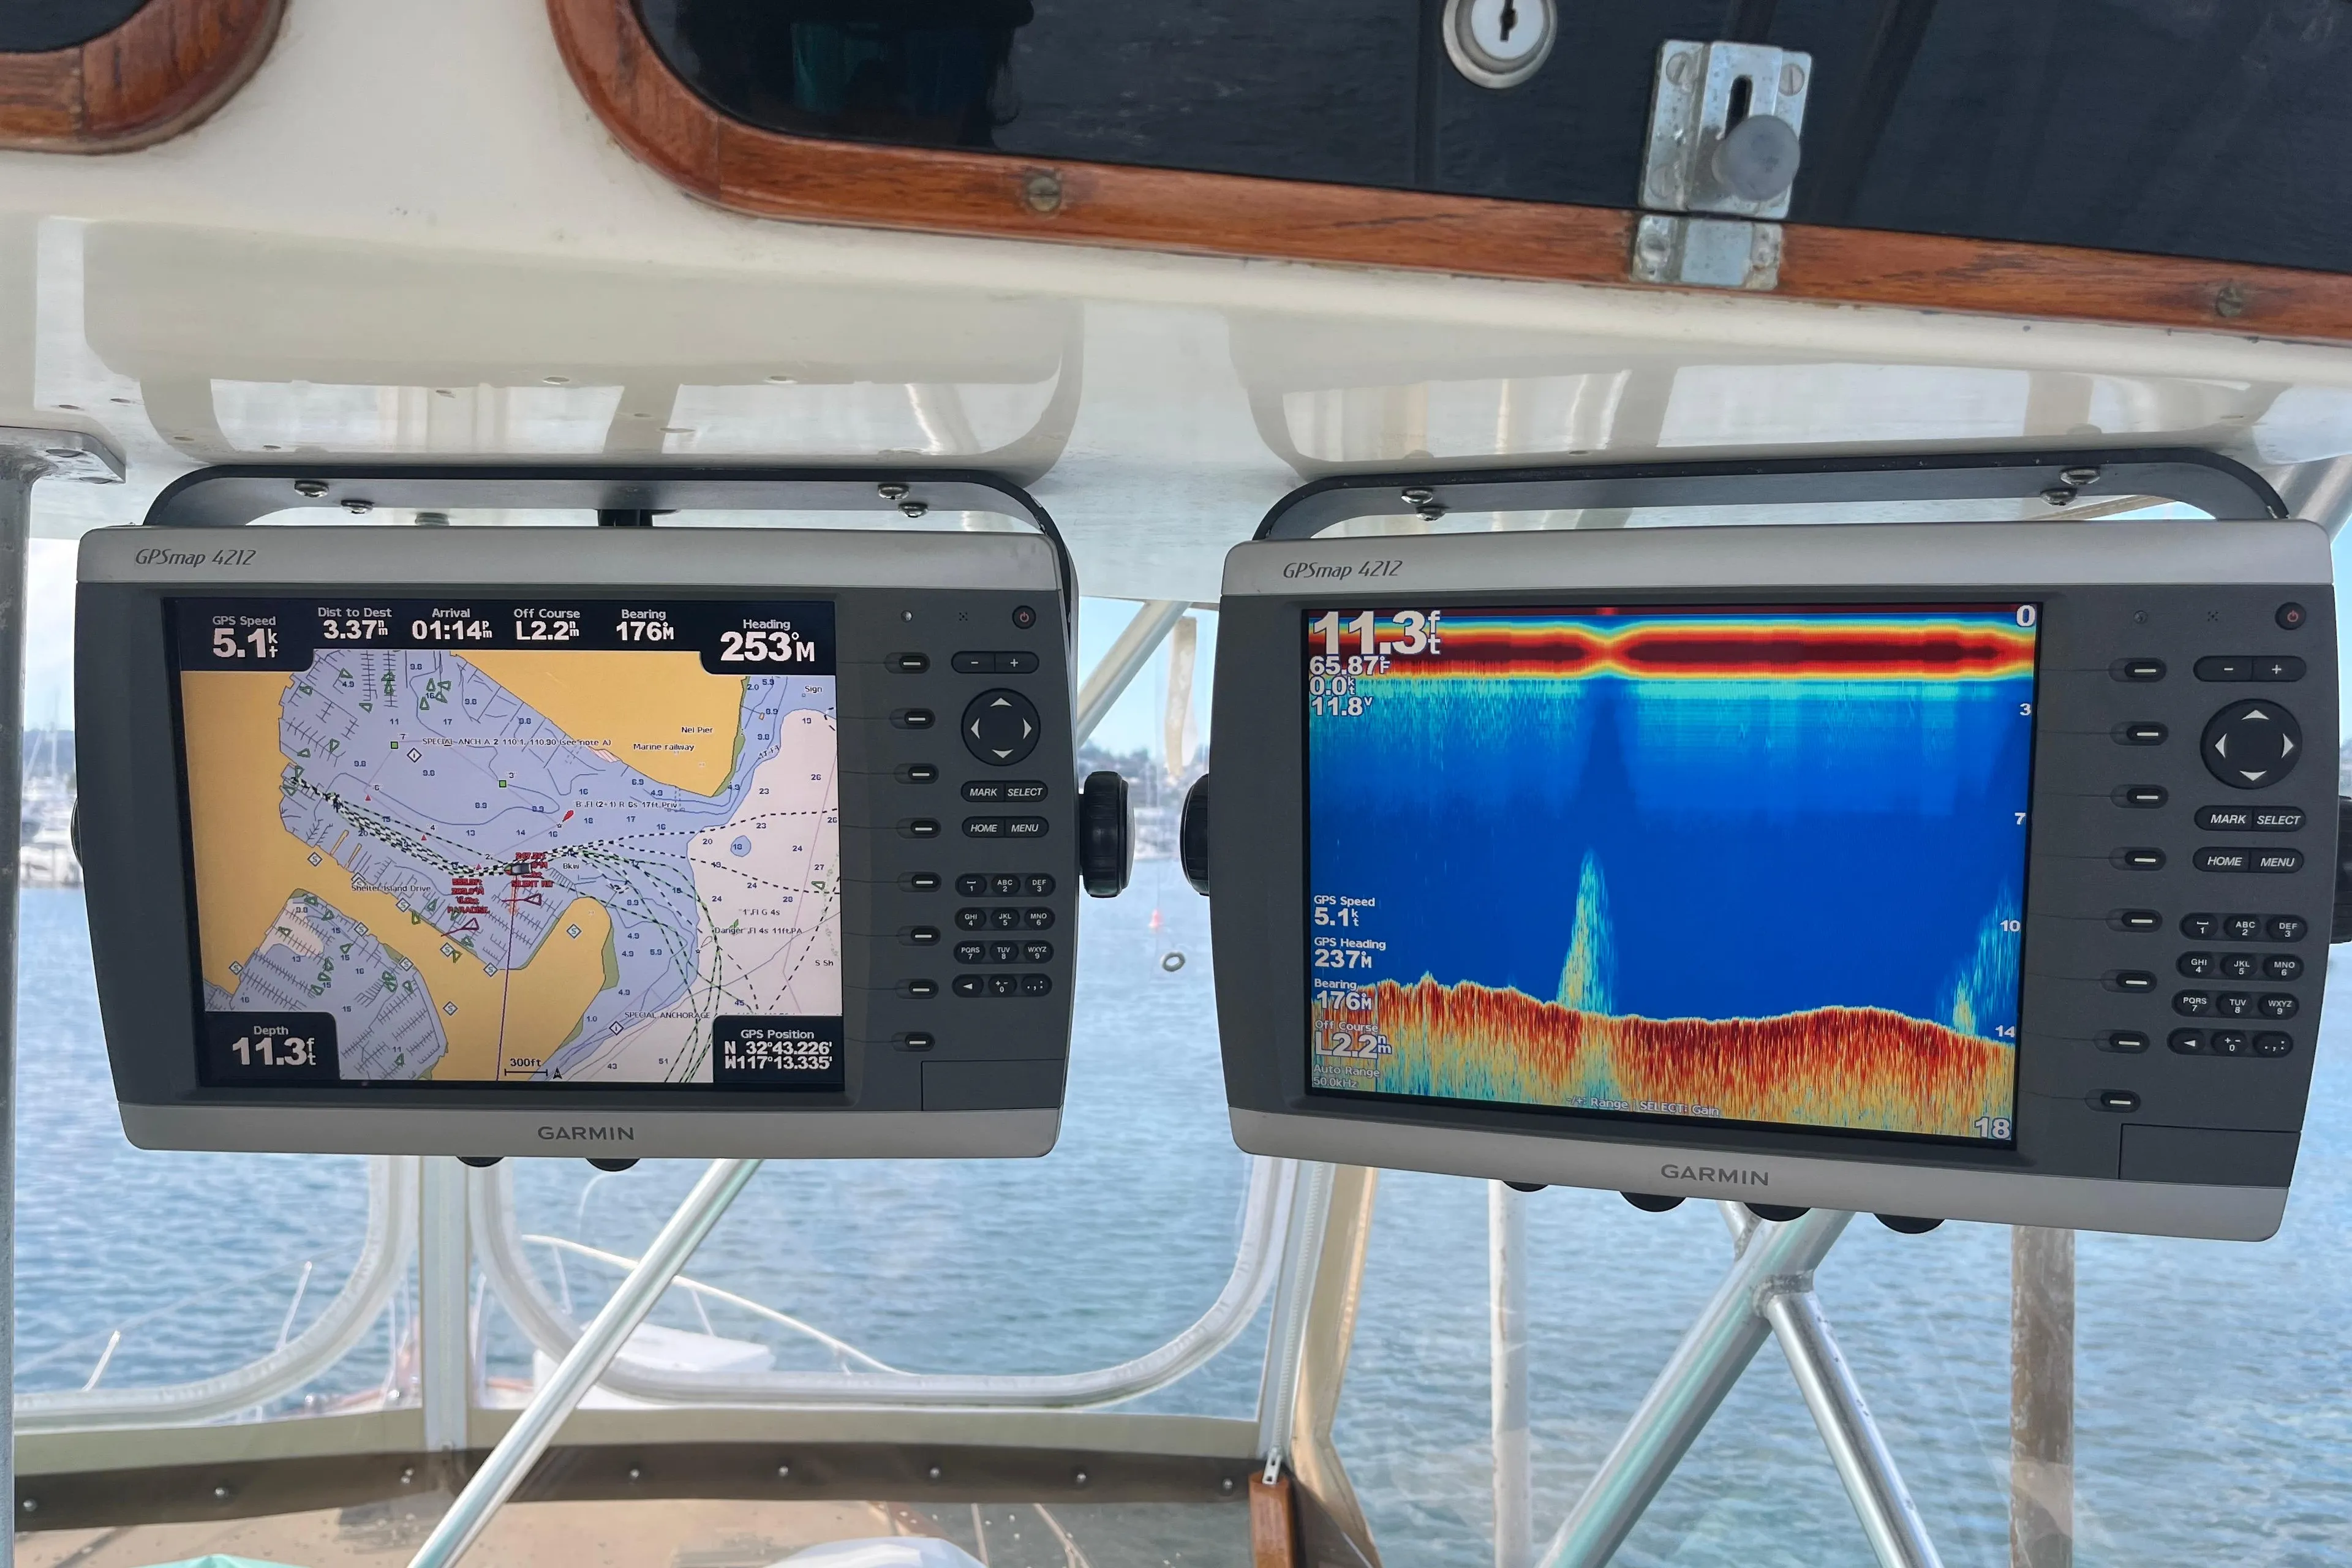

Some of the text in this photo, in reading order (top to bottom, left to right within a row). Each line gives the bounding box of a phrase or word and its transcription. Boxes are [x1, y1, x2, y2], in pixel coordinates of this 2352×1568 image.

[135, 548, 256, 567] GPSmap 4212
[1283, 560, 1403, 580] GPSmap 4212
[318, 608, 392, 617] Dist to Dest
[432, 608, 470, 618] Arrival
[514, 609, 580, 619] Off Course
[622, 609, 666, 620] Bearing
[2017, 605, 2035, 627] 0
[213, 616, 276, 628] GPS Speed
[743, 620, 791, 631] Heading
[2019, 703, 2031, 716] 3
[1008, 788, 1042, 796] SELECT
[2015, 812, 2026, 825] 7
[2211, 815, 2246, 824] MARK
[2257, 816, 2301, 824] SELECT
[2207, 857, 2242, 866] HOME
[2261, 858, 2294, 867] MENU
[1314, 895, 1375, 907] GPS Speed
[2000, 920, 2021, 932] 10
[1314, 937, 1386, 951] GPS Heading
[1314, 978, 1357, 990] Bearing
[254, 1026, 288, 1036] Depth
[1315, 1020, 1378, 1033] Off Course
[1996, 1025, 2016, 1038] 14
[741, 1030, 815, 1039] GPS Position
[725, 1041, 736, 1054] N
[510, 1058, 541, 1067] 300ft
[1313, 1065, 1380, 1077] Auto Range
[1591, 1098, 1628, 1110] Range
[1692, 1105, 1719, 1117] Gain
[538, 1126, 634, 1140] GARMIN
[1975, 1117, 2011, 1139] 18
[1660, 1163, 1769, 1186] GARMIN
